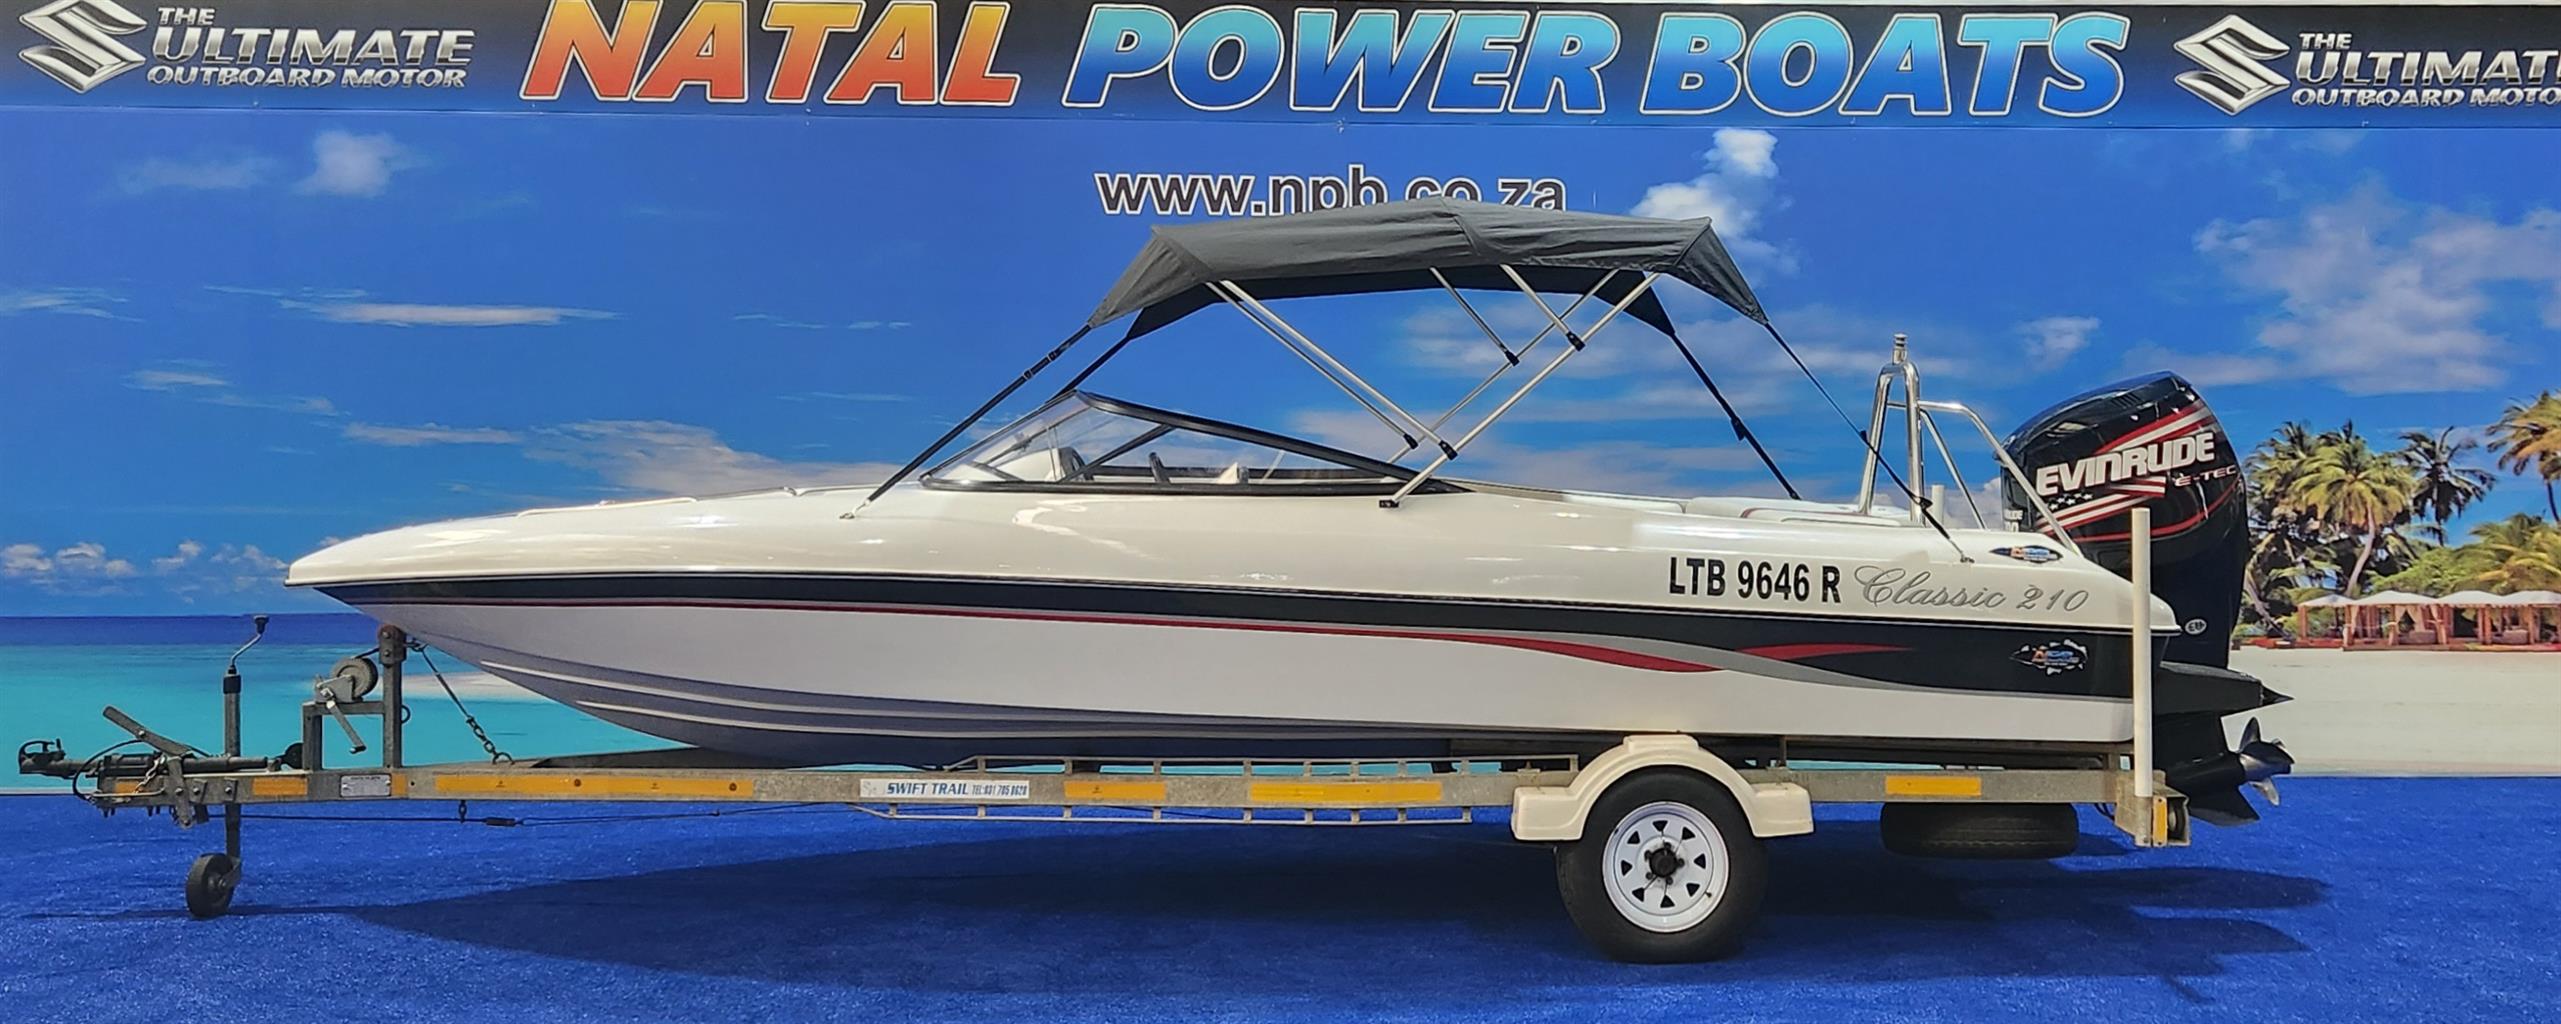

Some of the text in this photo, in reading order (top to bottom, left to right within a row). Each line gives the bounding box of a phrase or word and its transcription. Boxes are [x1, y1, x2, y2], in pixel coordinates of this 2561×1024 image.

[157, 7, 215, 26] THE
[151, 26, 476, 66] ULTIMATE
[2299, 33, 2352, 50] THE
[519, 0, 2132, 116] NATAL POWER BOATS
[2295, 50, 2561, 86] ULTIMAT
[146, 65, 468, 88] OUTBOARD MOTOR
[2291, 88, 2561, 108] OUTBOARD MOTO
[2034, 431, 2216, 497] EVINRUDE
[2174, 464, 2238, 487] E-TEC
[1669, 556, 1842, 603] LTB 9646 R
[1854, 564, 2089, 612] Classic 210
[887, 782, 927, 795] SWIFT
[932, 783, 969, 795] TRAIL
